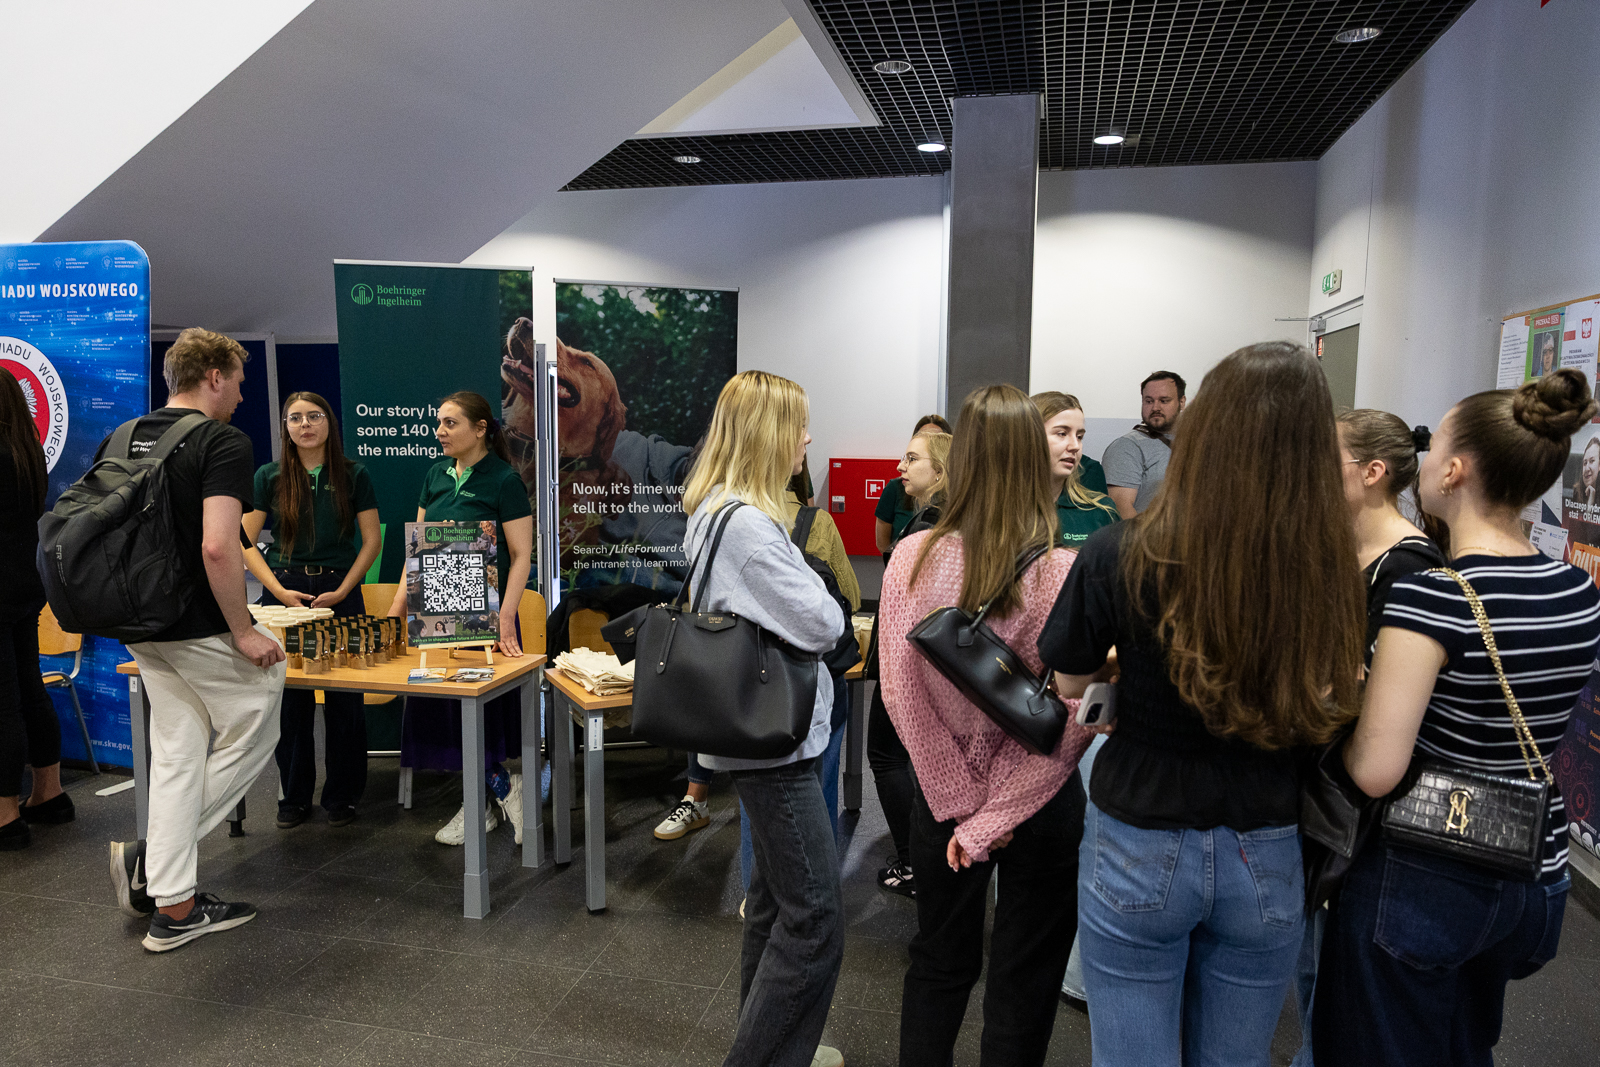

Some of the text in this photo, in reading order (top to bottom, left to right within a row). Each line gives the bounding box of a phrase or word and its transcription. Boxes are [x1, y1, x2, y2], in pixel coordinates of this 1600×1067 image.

[0, 283, 138, 298] IADU WOJSKOWEGO
[376, 285, 426, 297] Boehringer
[377, 296, 422, 307] Ingelheim
[0, 342, 32, 360] IADU
[356, 404, 384, 417] Our
[387, 405, 425, 420] story
[357, 425, 398, 437] some
[401, 424, 429, 437] 140
[358, 443, 382, 456] the
[572, 482, 686, 497] Now, it's time we
[572, 501, 596, 514] tell
[598, 501, 608, 514] it
[610, 502, 625, 513] to
[627, 501, 650, 513] the
[443, 527, 477, 537] Boehringer
[443, 535, 474, 543] Ingelheim
[573, 545, 608, 555] Search
[609, 543, 678, 556] /LifeForward
[573, 558, 690, 569] the intranet to learn mor
[90, 739, 132, 751] ww.skw.gov.
